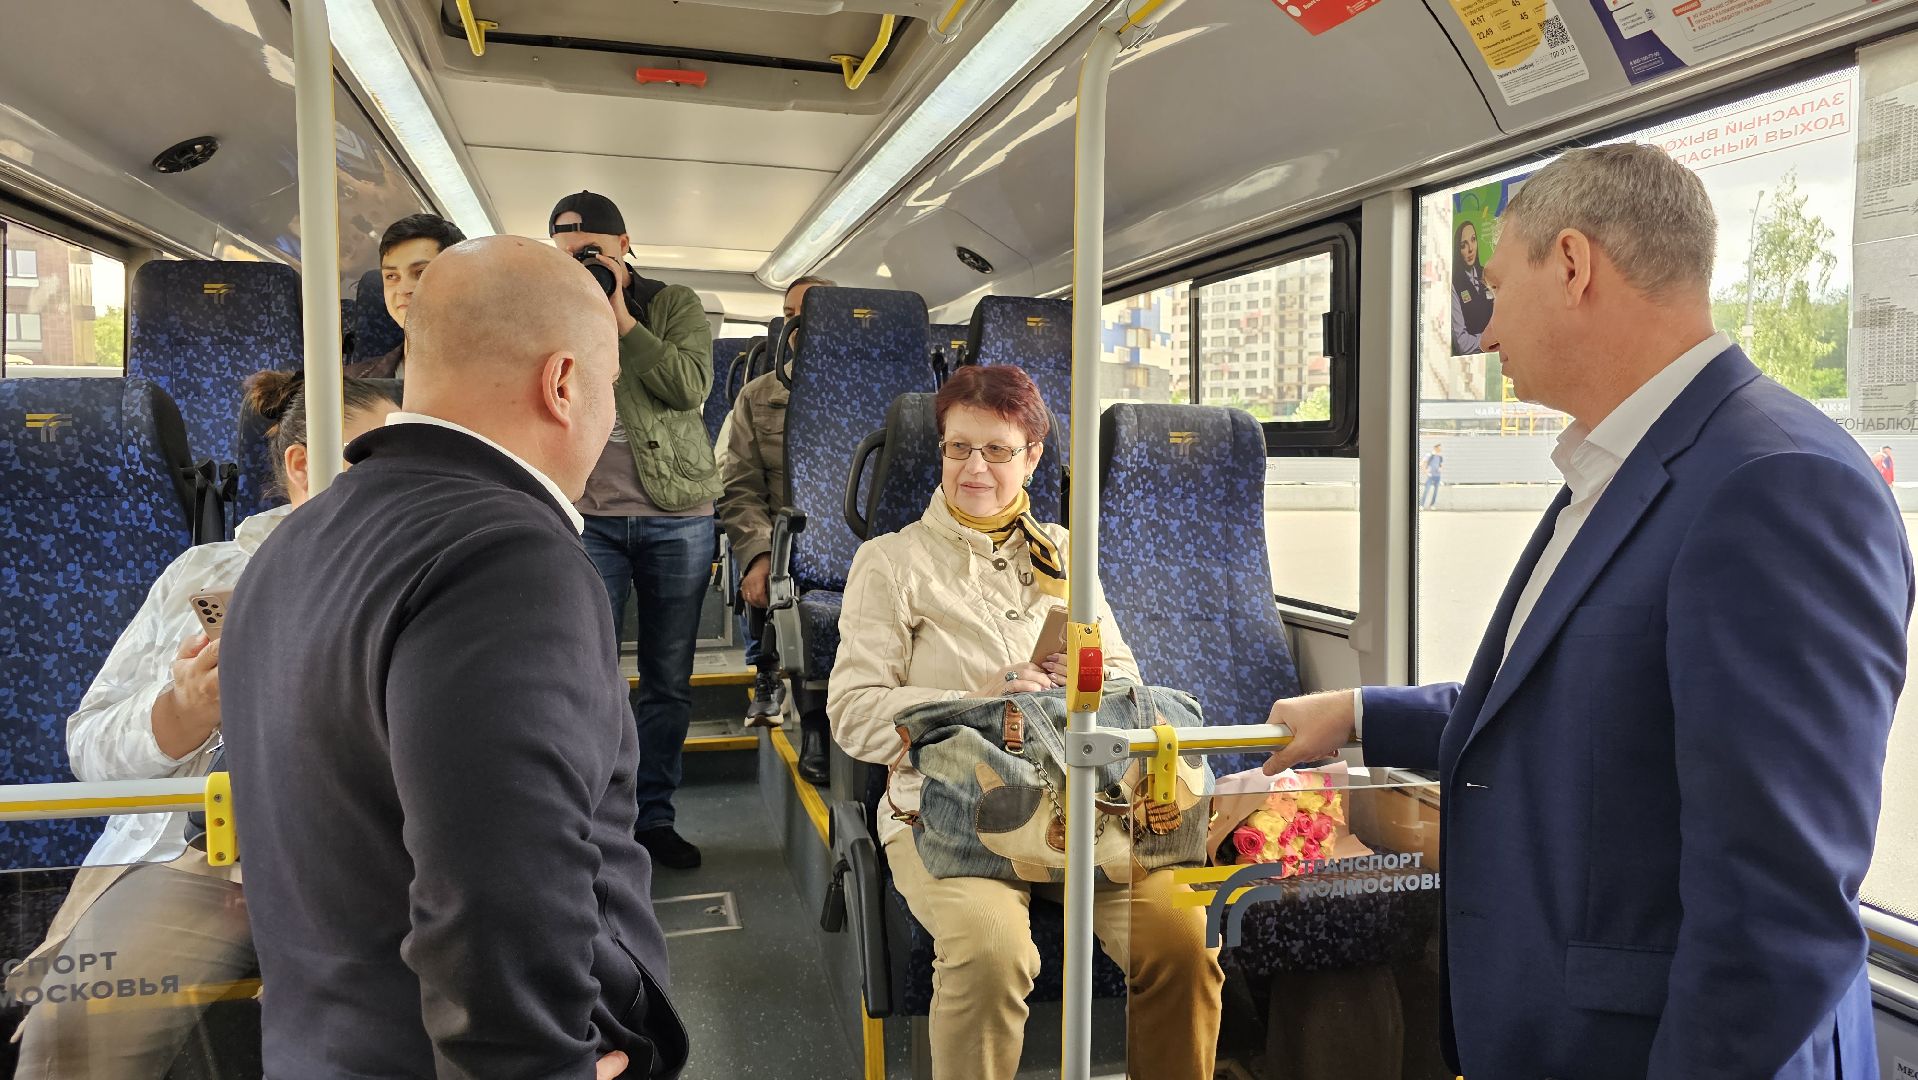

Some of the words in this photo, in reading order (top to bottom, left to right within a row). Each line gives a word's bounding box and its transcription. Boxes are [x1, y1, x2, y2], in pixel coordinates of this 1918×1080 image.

[1519, 11, 1529, 21] 45
[1765, 112, 1845, 144] ВЫХОД
[1300, 851, 1424, 877] ТРАНСПОРТ
